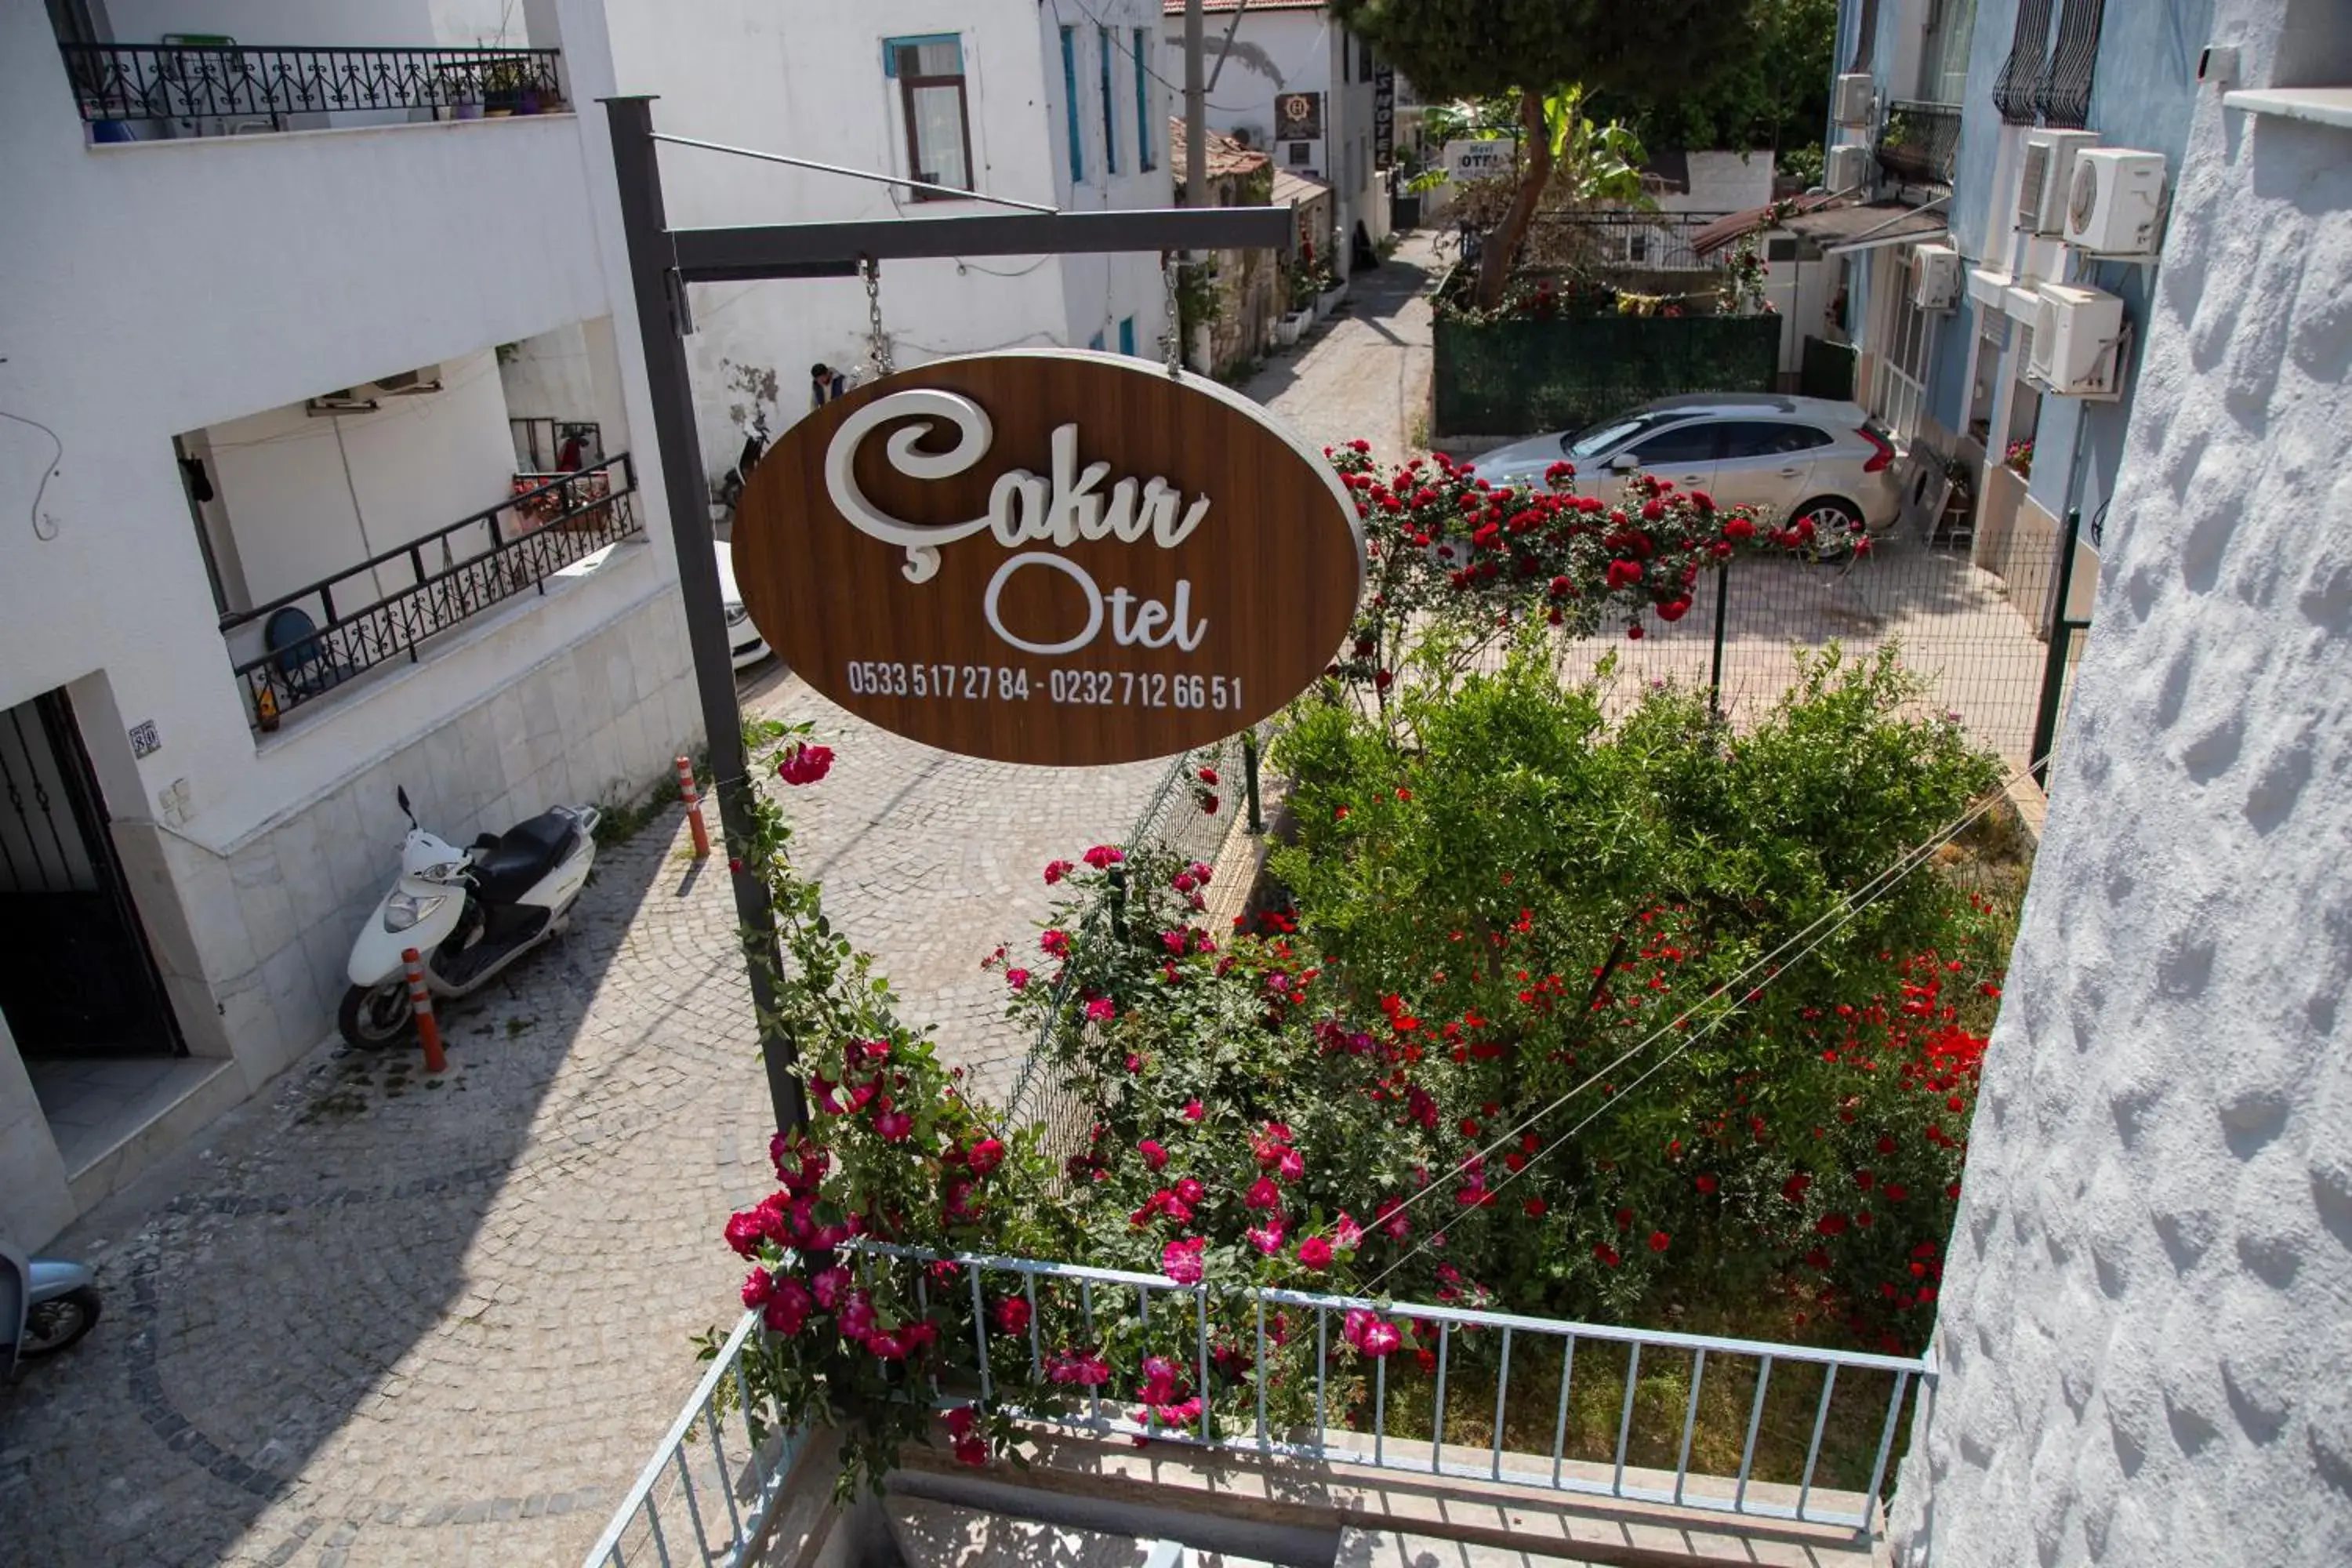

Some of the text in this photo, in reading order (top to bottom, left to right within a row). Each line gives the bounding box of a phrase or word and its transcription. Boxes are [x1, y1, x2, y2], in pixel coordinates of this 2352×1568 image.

[825, 389, 1210, 583] Çakır
[985, 551, 1208, 655] Otel
[847, 661, 907, 696] 0533
[913, 664, 956, 698] 517
[963, 666, 993, 699] 27
[998, 667, 1029, 701] 84
[1050, 670, 1114, 705] 0232
[1119, 672, 1167, 708] 712
[1174, 674, 1205, 710] 66
[1211, 676, 1243, 710] 51
